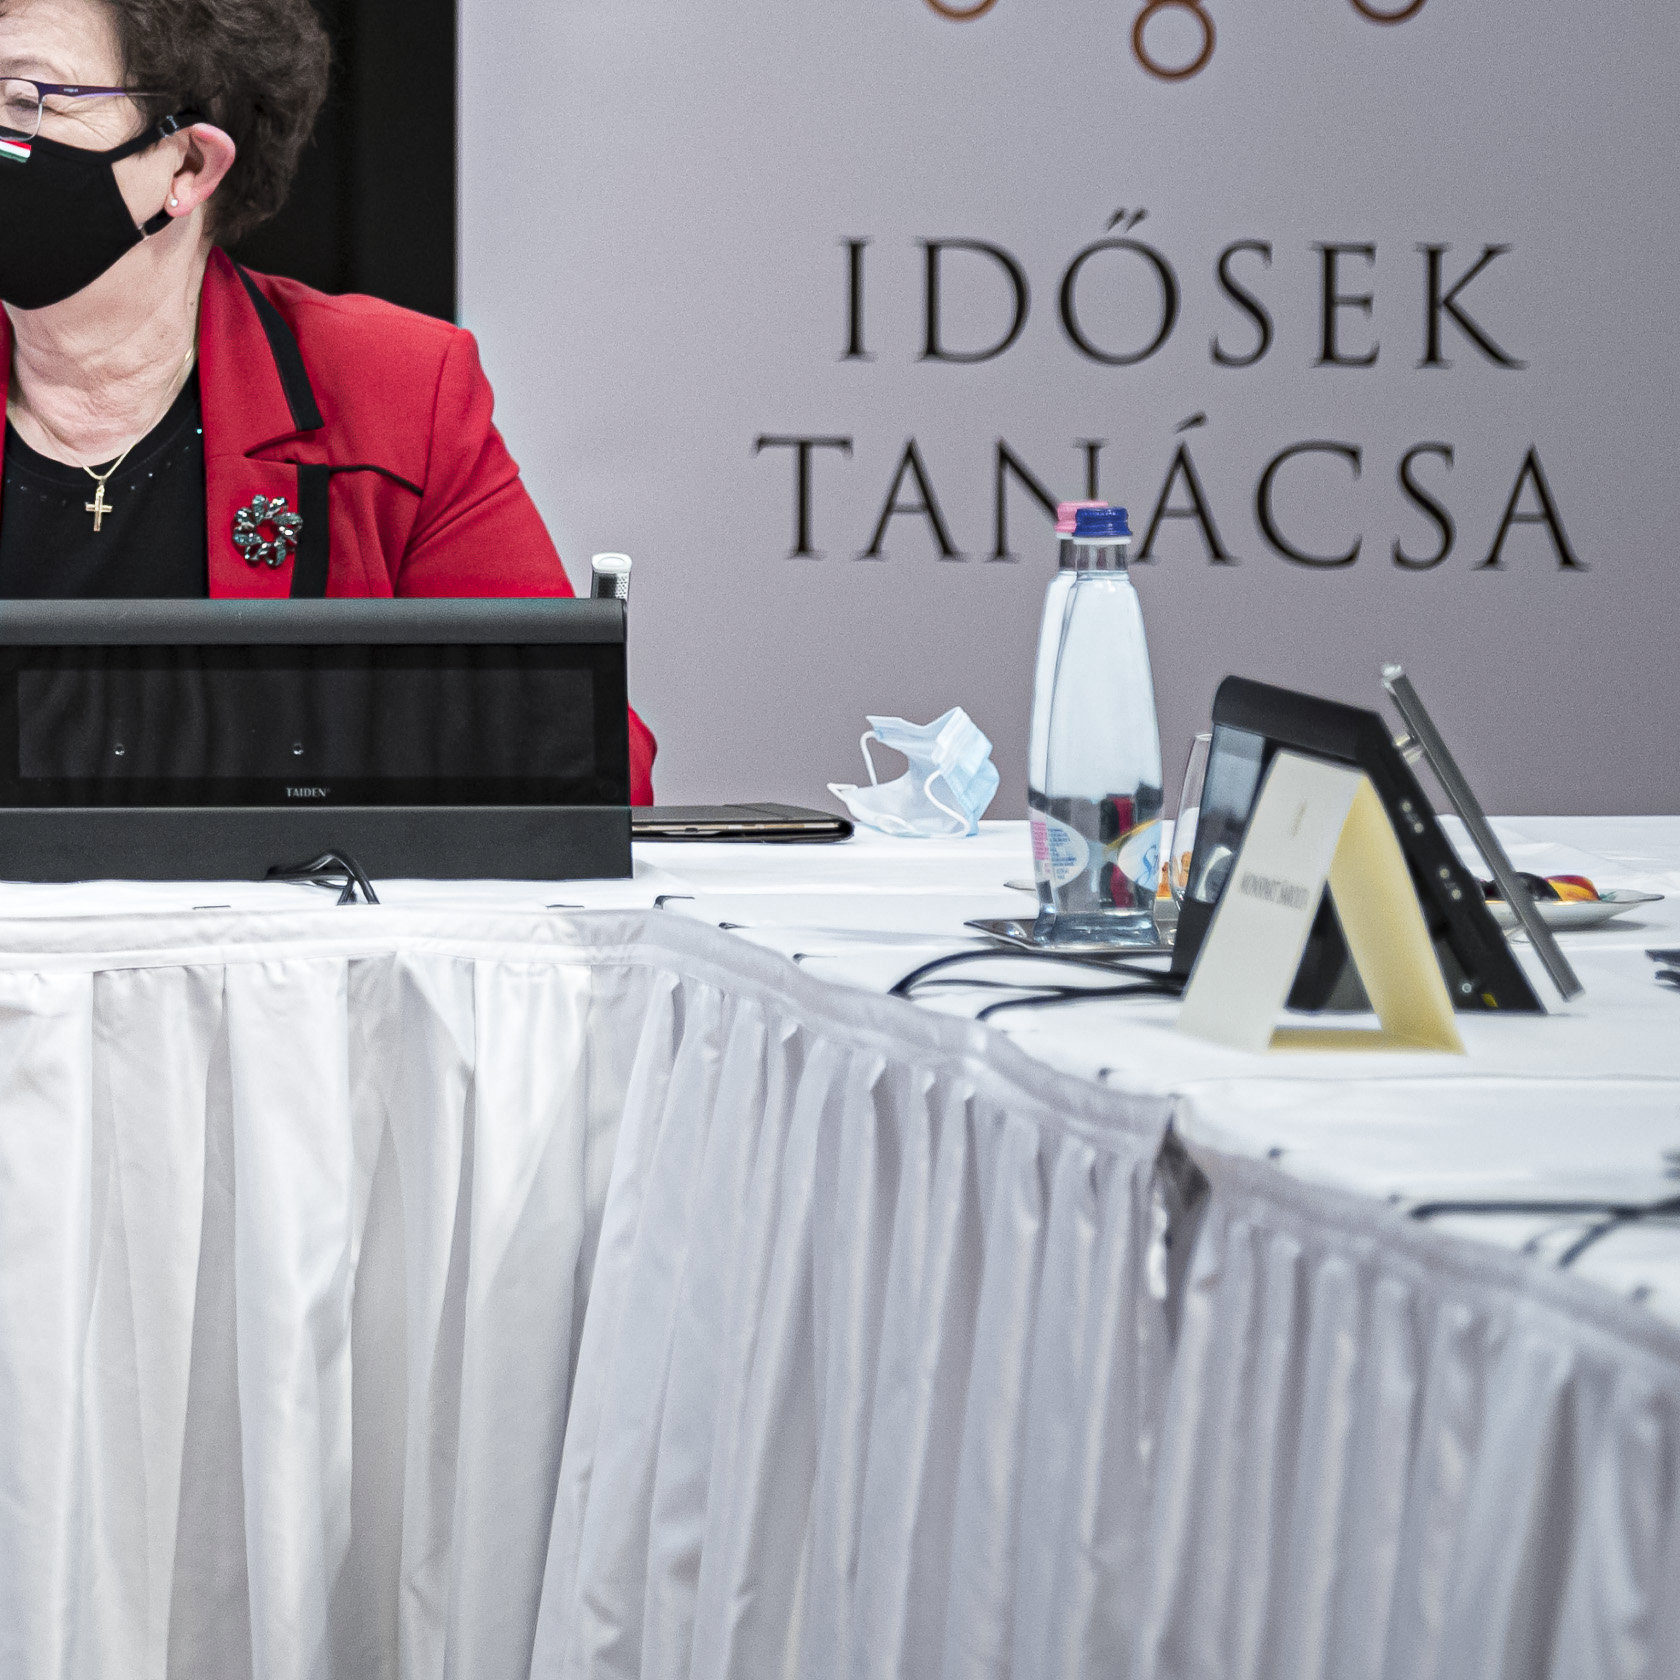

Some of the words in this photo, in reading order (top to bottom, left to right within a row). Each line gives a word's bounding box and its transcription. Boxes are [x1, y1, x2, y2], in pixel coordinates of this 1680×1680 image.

[839, 208, 1529, 370] IDŐSEK
[753, 412, 1591, 571] TANÁCSA
[286, 787, 327, 798] TAIDEN
